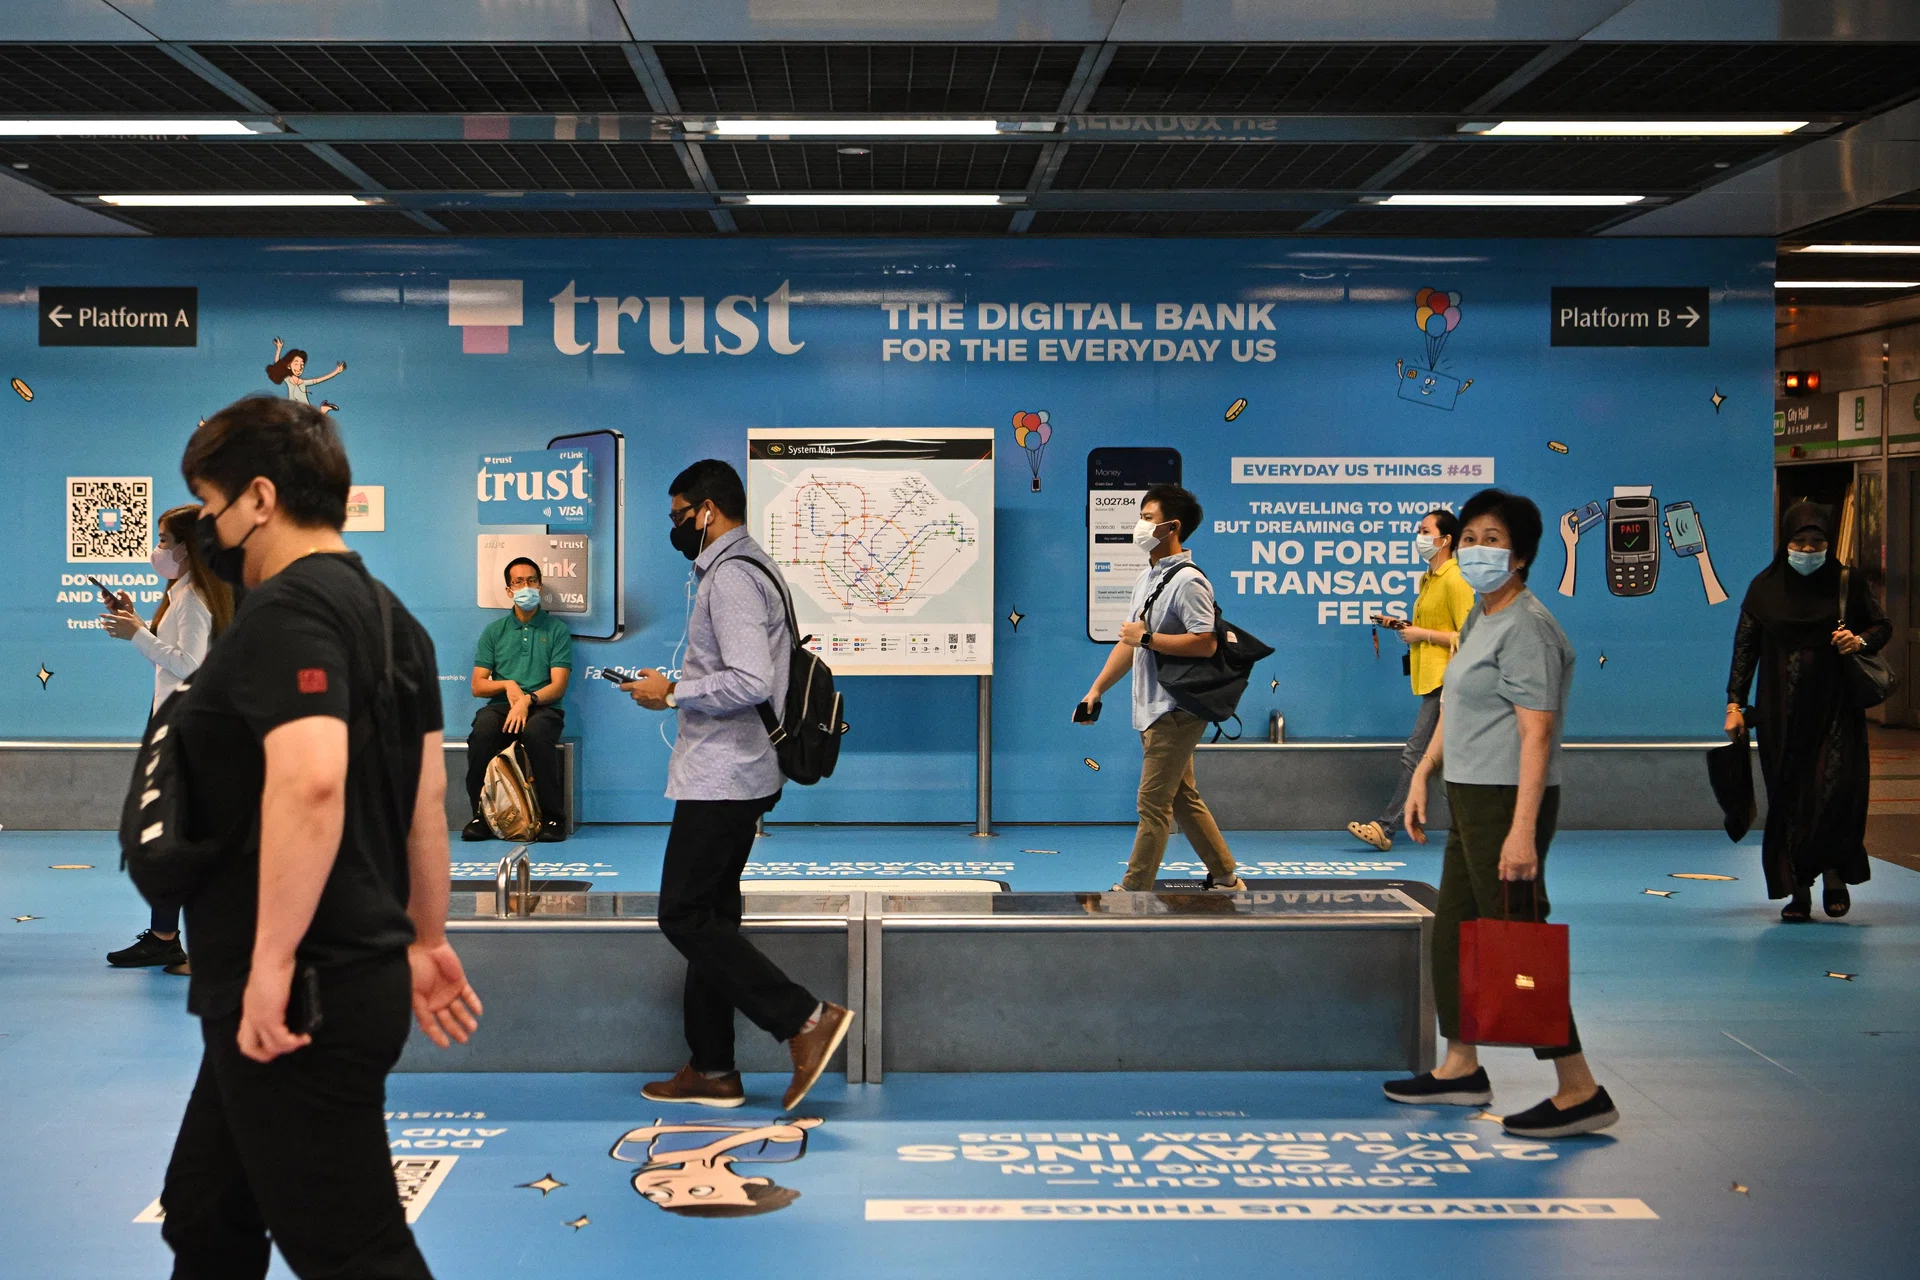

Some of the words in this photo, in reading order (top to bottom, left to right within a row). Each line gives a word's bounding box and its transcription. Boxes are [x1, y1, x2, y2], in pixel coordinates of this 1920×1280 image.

[79, 306, 168, 328] Platform
[174, 308, 190, 328] A
[549, 279, 806, 356] trust
[881, 301, 964, 332] THE
[974, 301, 1148, 332] DIGITAL
[1155, 302, 1277, 331] BANK
[1560, 306, 1650, 328] Platform
[1657, 309, 1671, 328] B
[882, 338, 949, 363] FOR
[960, 338, 1028, 363] THE
[1039, 338, 1221, 363] EVERYDAY
[1231, 338, 1277, 363] US
[567, 451, 583, 460] Link
[788, 444, 817, 456] System
[818, 444, 836, 456] Map
[491, 456, 512, 464] trust
[1095, 468, 1121, 477] Money
[1243, 463, 1340, 477] EVERYDAY
[1344, 463, 1369, 477] US
[1373, 463, 1443, 477] THINGS
[1446, 463, 1483, 477] #45
[477, 460, 588, 502] trust
[1095, 497, 1136, 507] 3,027.84
[1249, 501, 1363, 515] TRAVELLING
[1368, 502, 1393, 515] TO
[1397, 501, 1454, 515] WORK
[557, 506, 584, 516] VISA
[1213, 521, 1251, 534] BUT
[1255, 520, 1355, 534] DREAMING
[1359, 521, 1384, 534] OF
[1388, 521, 1421, 534] TRA
[1620, 524, 1641, 534] PAID
[559, 540, 585, 549] trust
[1251, 540, 1305, 564] NO
[1314, 540, 1421, 565] FOREI
[541, 557, 578, 578] ink
[61, 574, 159, 586] DOWNLOAD
[1230, 570, 1427, 596] TRANSACT
[56, 591, 94, 603] AND
[140, 591, 164, 603] UP
[559, 593, 584, 604] VISA
[1317, 601, 1408, 625] FEES
[401, 1127, 508, 1138] AND
[957, 1132, 1121, 1143] NEEDS
[1136, 1131, 1393, 1142] EVERYDAY
[1405, 1131, 1480, 1142] ON
[897, 1143, 1331, 1163] SAVINGS
[1354, 1143, 1560, 1162] 21%
[1000, 1163, 1076, 1175] ON
[1089, 1163, 1142, 1175] IN
[1155, 1163, 1355, 1175] ZONING
[1370, 1163, 1472, 1174] BUT
[1112, 1176, 1221, 1188] OUT
[1233, 1176, 1439, 1188] ZONING
[1021, 1204, 1227, 1215] THINGS
[1238, 1204, 1312, 1215] US
[1331, 1203, 1618, 1215] EVERYDAY
